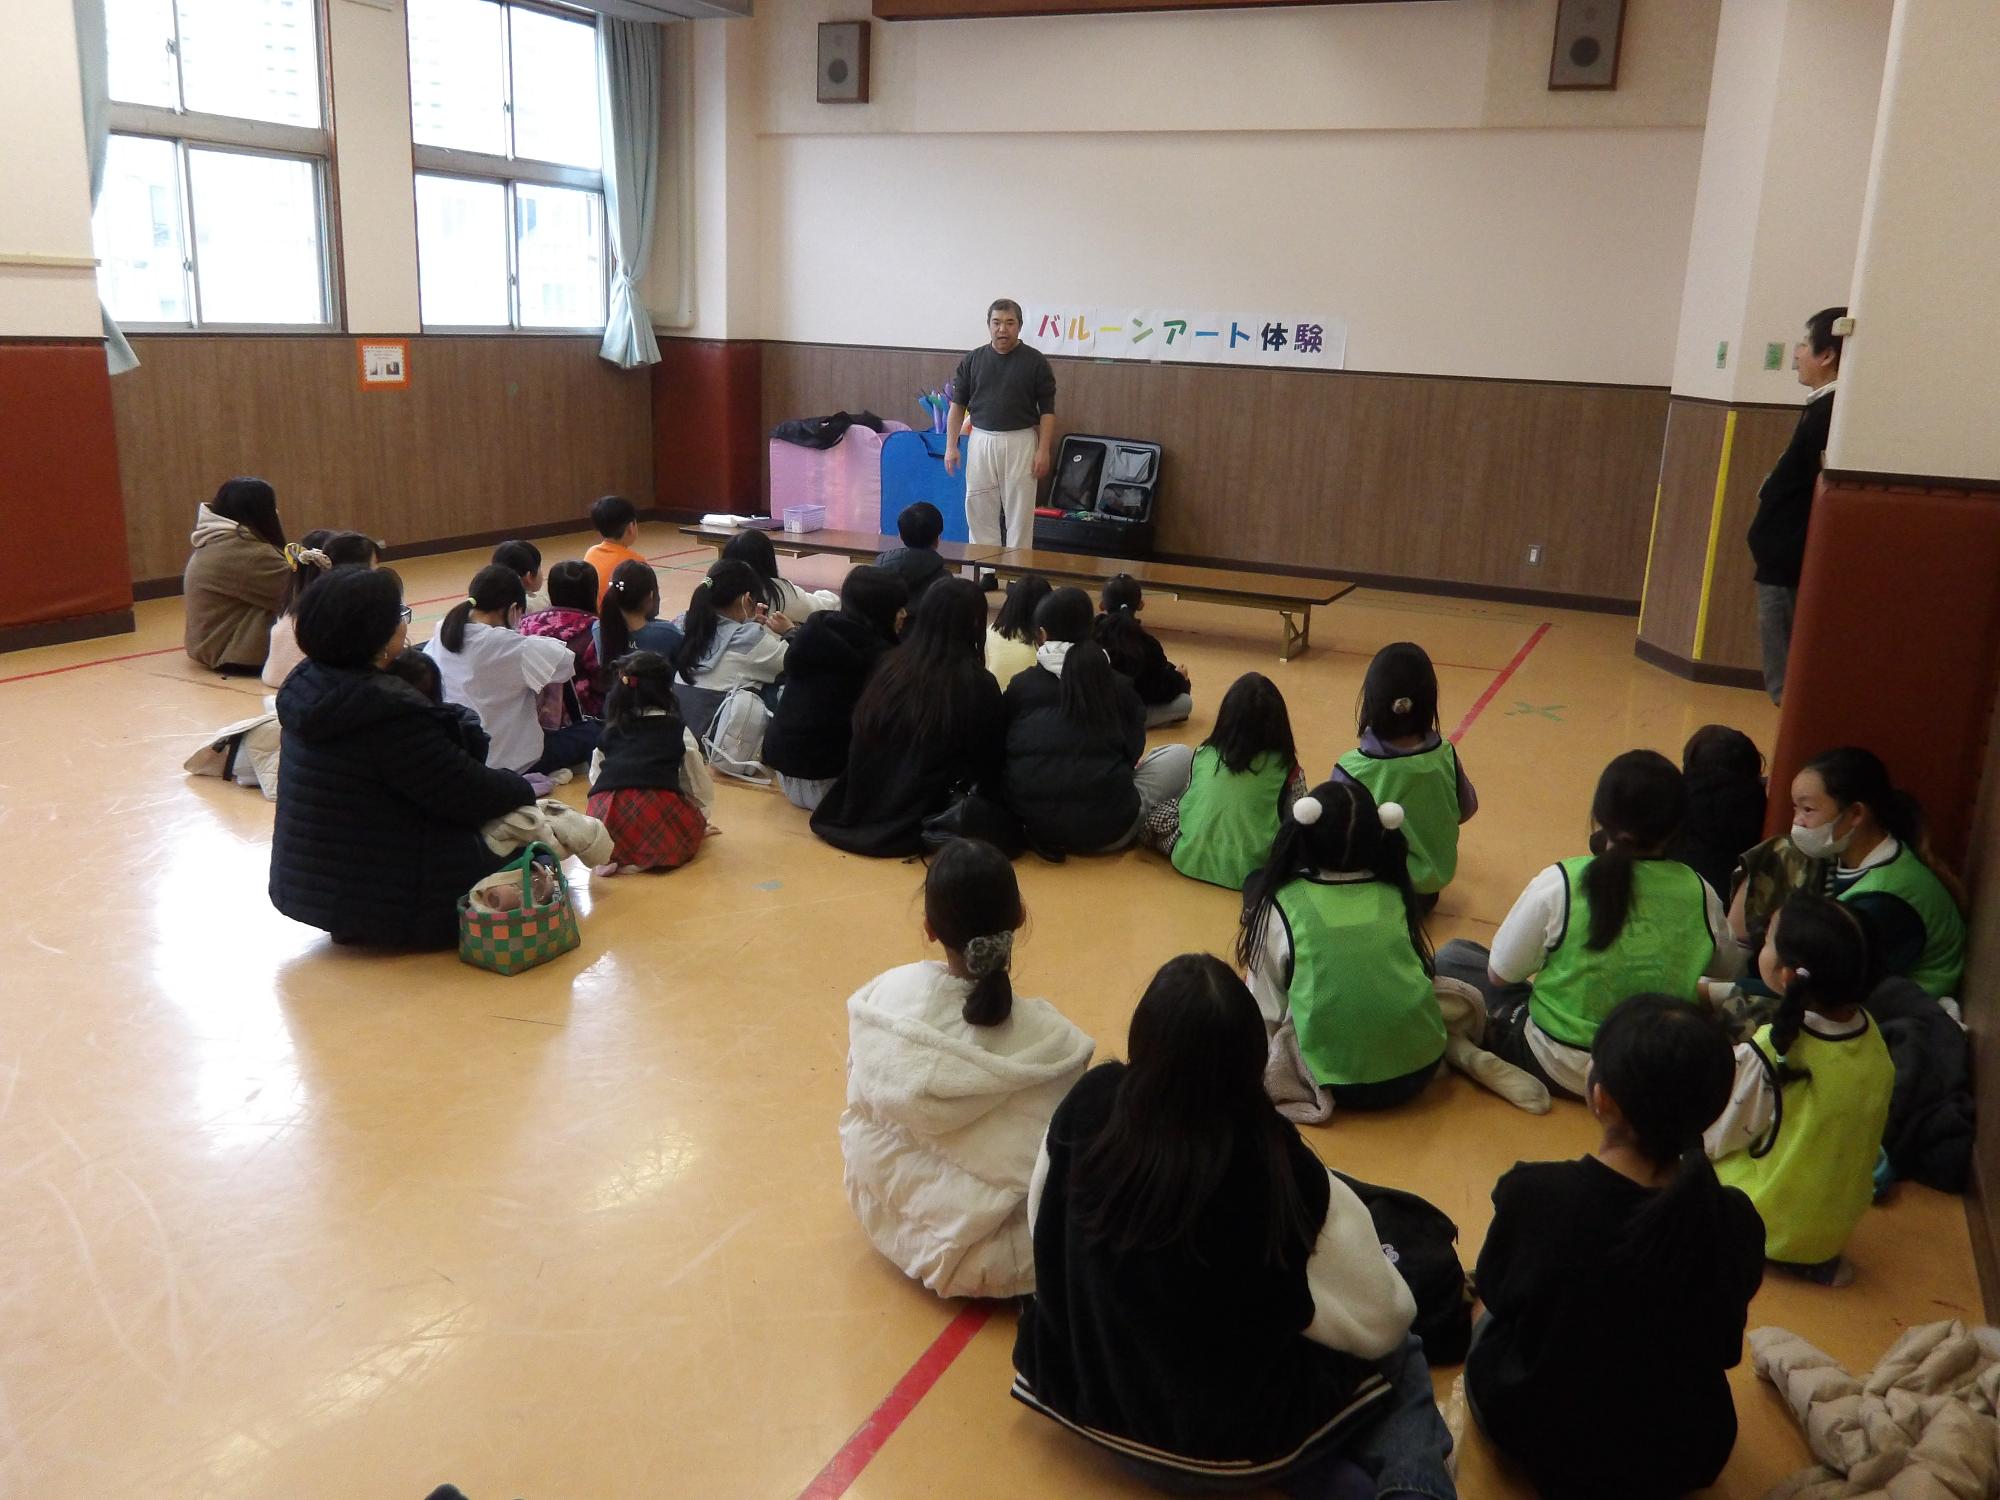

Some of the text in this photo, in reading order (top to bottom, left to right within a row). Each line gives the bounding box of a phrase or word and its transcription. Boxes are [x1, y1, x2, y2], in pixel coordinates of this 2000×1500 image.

[1038, 313, 1324, 354] バルーンアート体験
